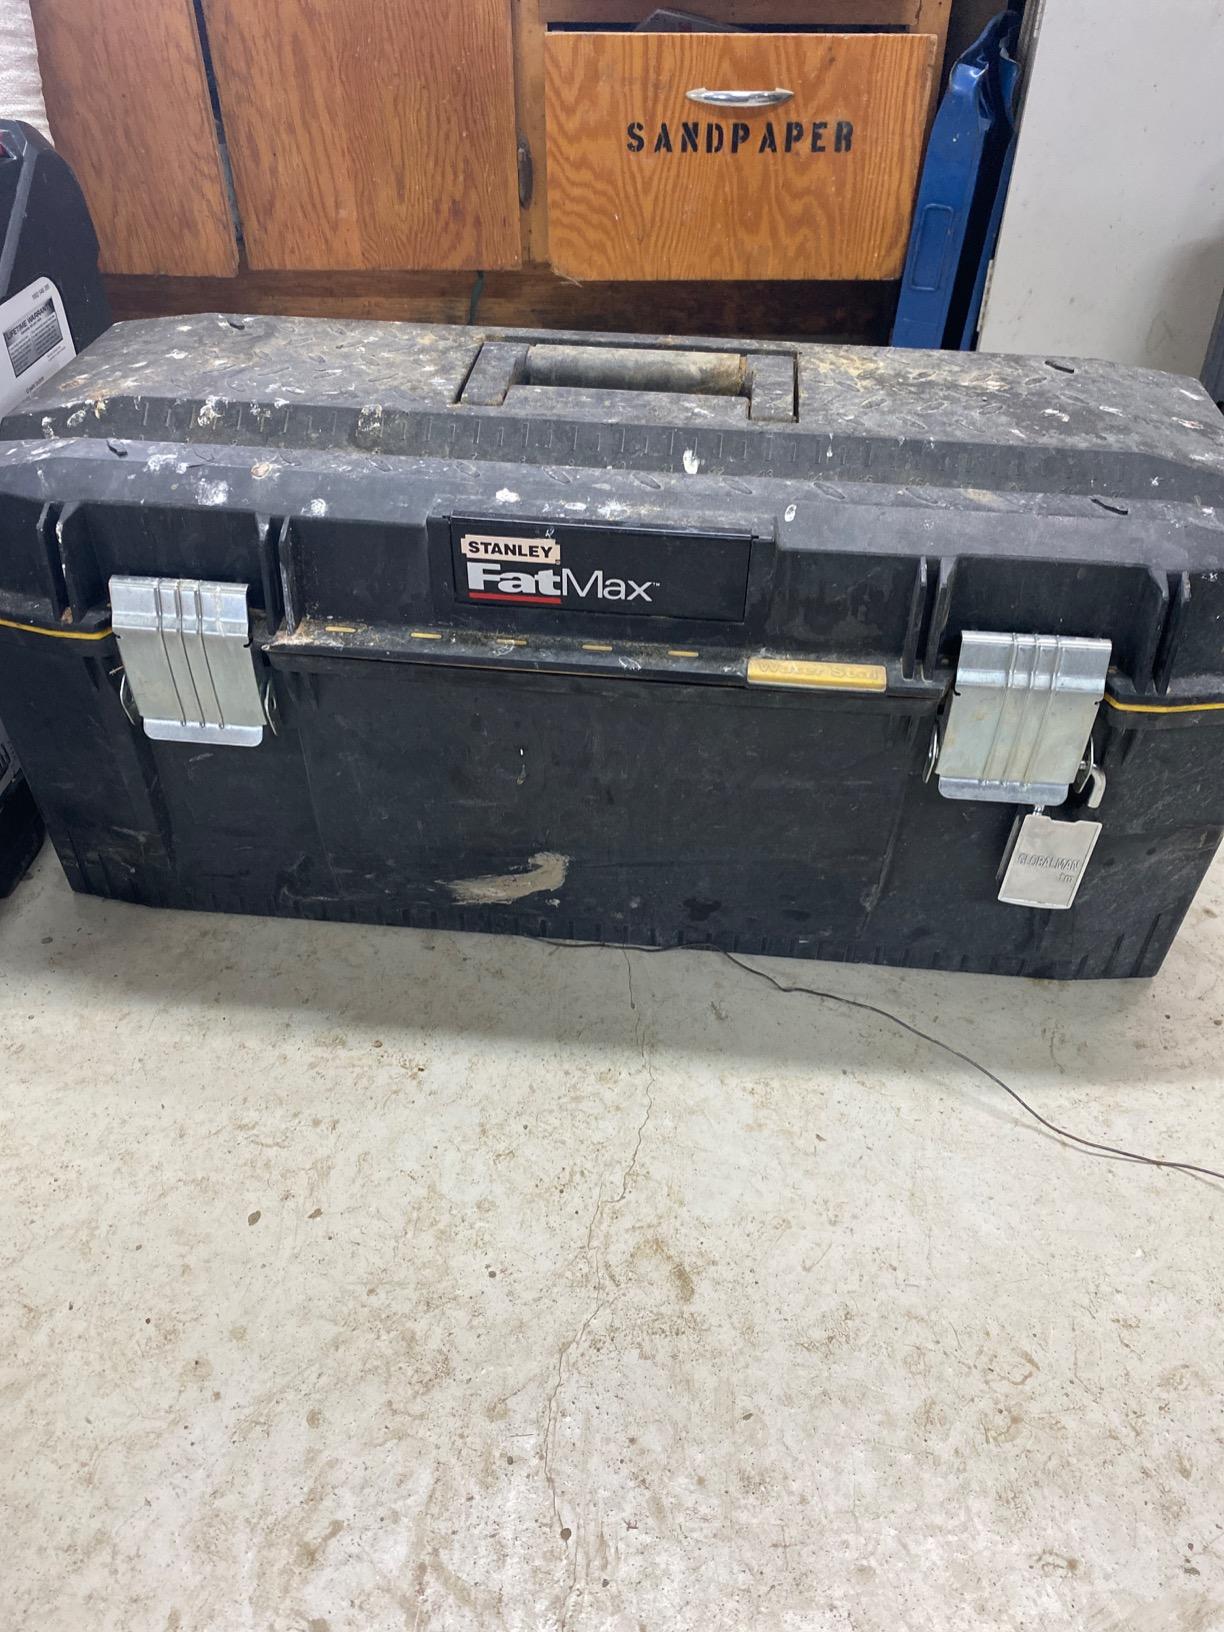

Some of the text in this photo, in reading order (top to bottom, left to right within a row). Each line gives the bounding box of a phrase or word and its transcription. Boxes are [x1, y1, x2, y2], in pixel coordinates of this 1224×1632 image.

[626, 121, 855, 154] SANDPAPER
[7, 318, 28, 340] LIFETIME
[468, 540, 553, 559] STANLEY
